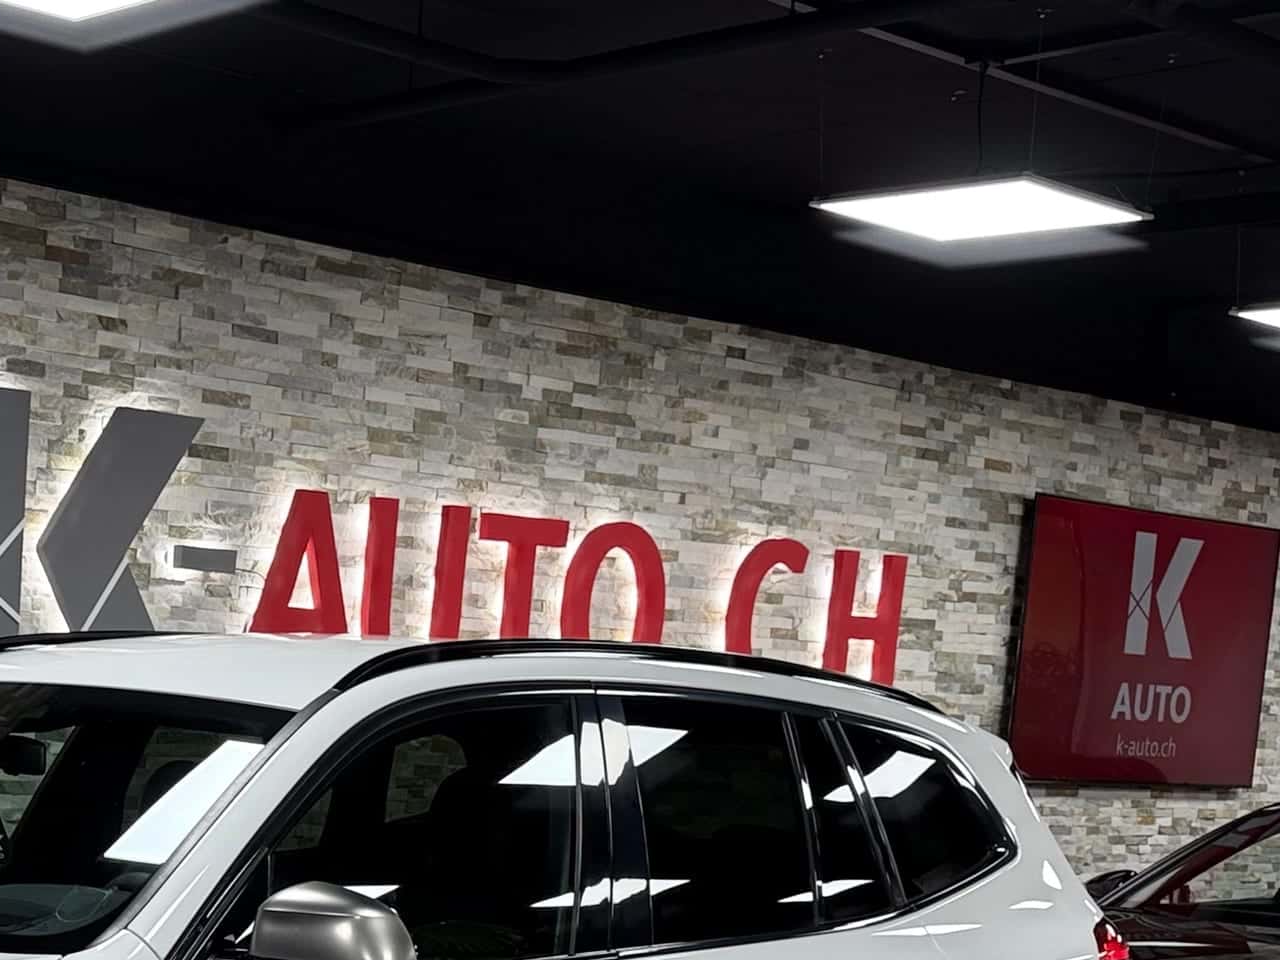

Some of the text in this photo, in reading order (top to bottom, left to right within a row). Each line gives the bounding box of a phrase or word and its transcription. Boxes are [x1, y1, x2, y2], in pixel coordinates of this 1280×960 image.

[1123, 530, 1205, 660] K
[1110, 682, 1192, 724] AUTO
[1116, 733, 1176, 758] k-auto.ch
